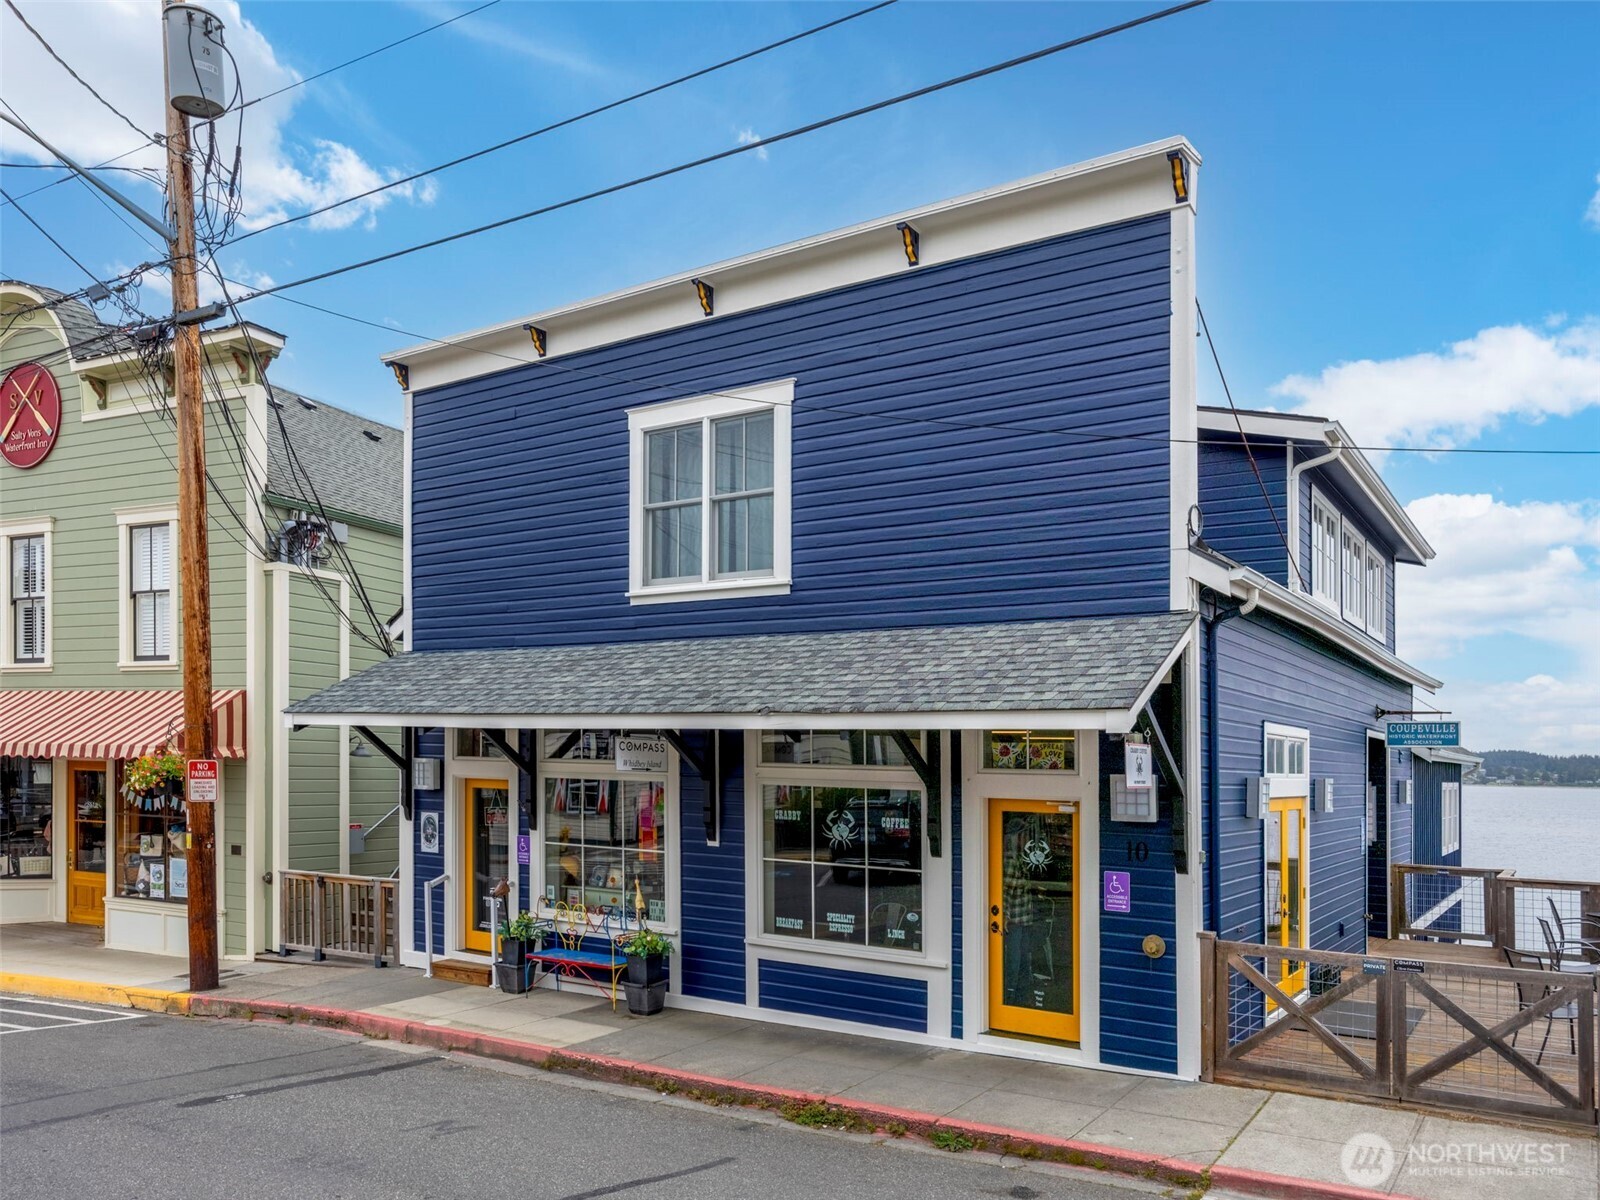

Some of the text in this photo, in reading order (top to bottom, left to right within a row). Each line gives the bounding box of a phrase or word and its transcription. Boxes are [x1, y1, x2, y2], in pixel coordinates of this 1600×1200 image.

[11, 430, 26, 441] Salty
[5, 438, 48, 452] Waterfront Inn
[1389, 723, 1457, 733] COUPEVILLE
[619, 741, 665, 752] COMPASS
[1044, 751, 1062, 759] LOVE
[622, 759, 646, 768] Whidbey
[191, 770, 215, 778] PARKING
[774, 810, 801, 821] CRABBY
[881, 817, 910, 829] COFFEE
[1126, 841, 1148, 862] 10
[776, 917, 803, 929] BREAKFAST
[829, 923, 854, 933] ESPRESSO
[887, 929, 905, 939] LUNCH
